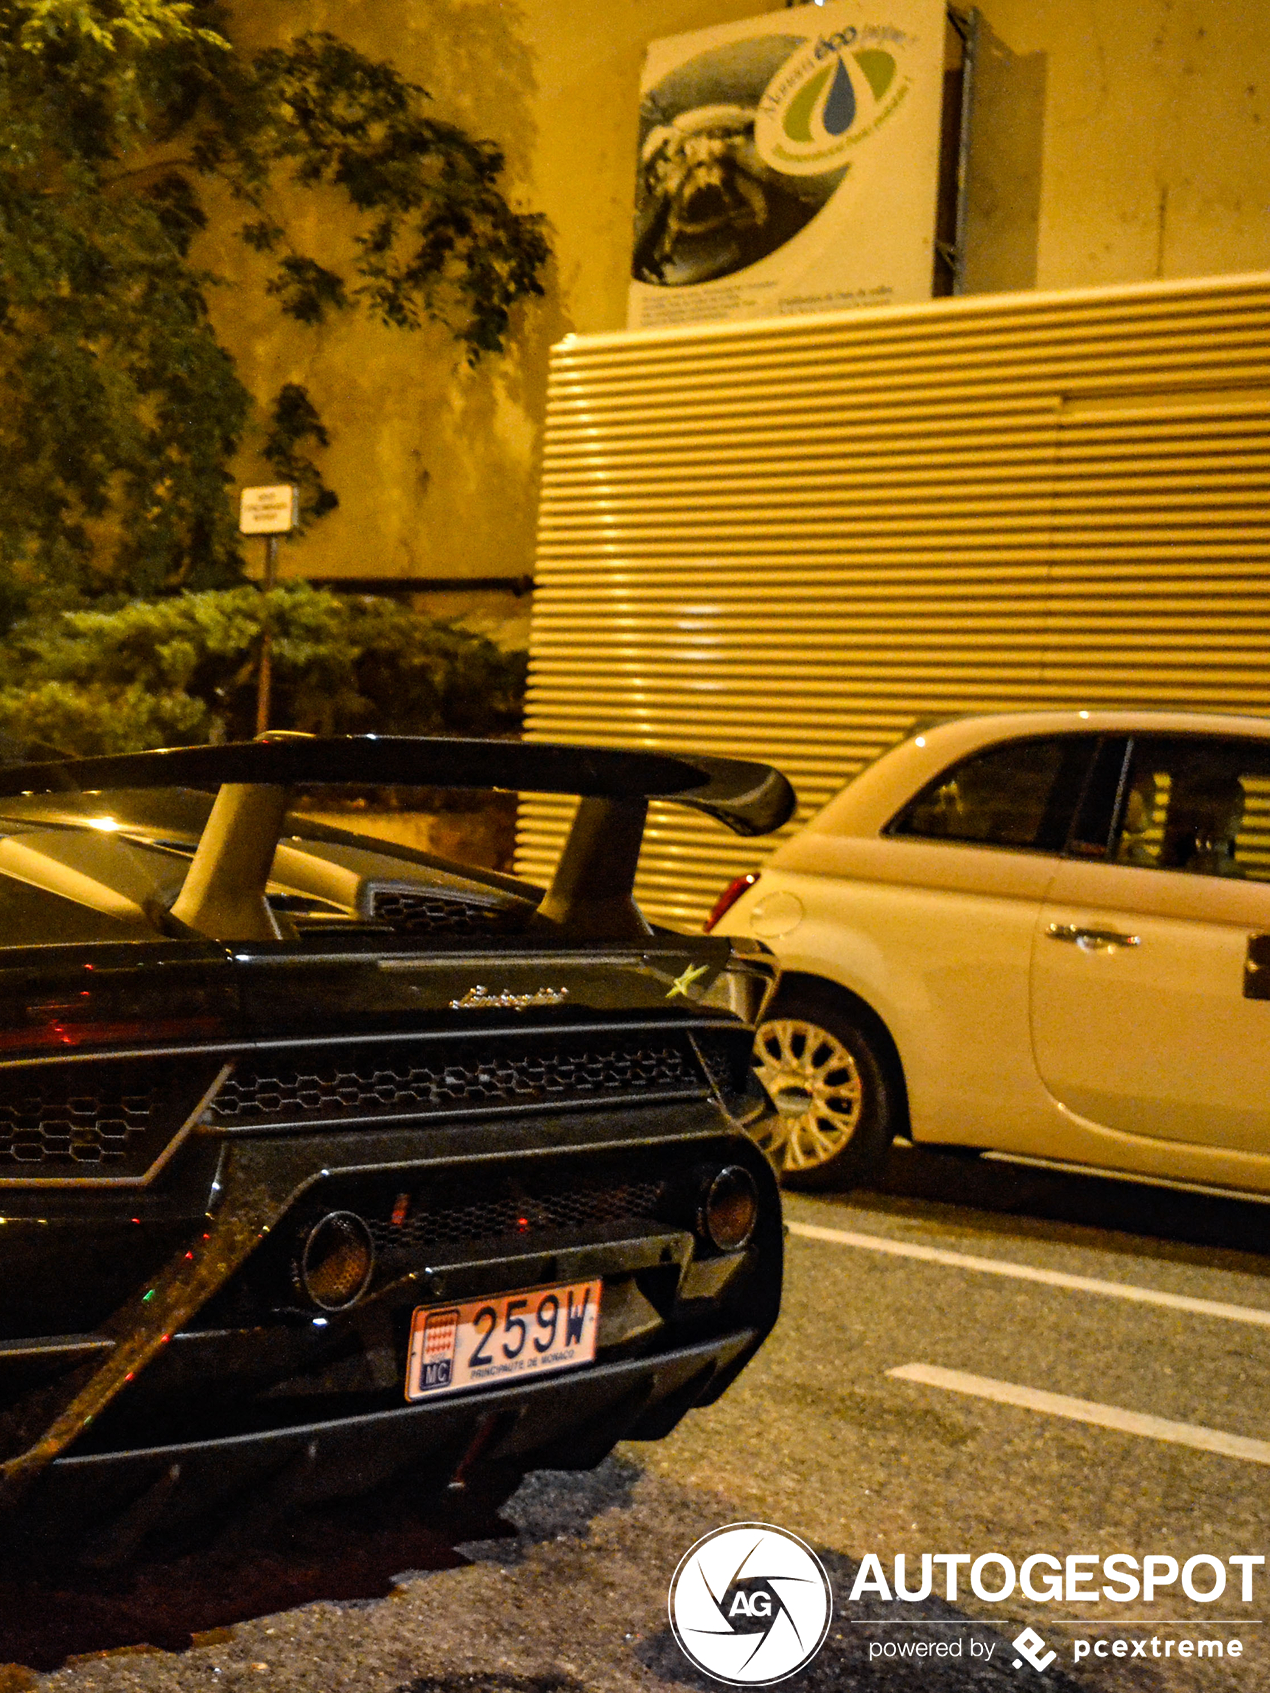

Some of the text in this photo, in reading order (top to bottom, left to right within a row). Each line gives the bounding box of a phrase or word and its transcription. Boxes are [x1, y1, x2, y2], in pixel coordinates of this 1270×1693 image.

[468, 1286, 590, 1368] 259W
[426, 1362, 448, 1384] MC
[471, 1349, 575, 1380] PRINCIPAUTE DE MONACO
